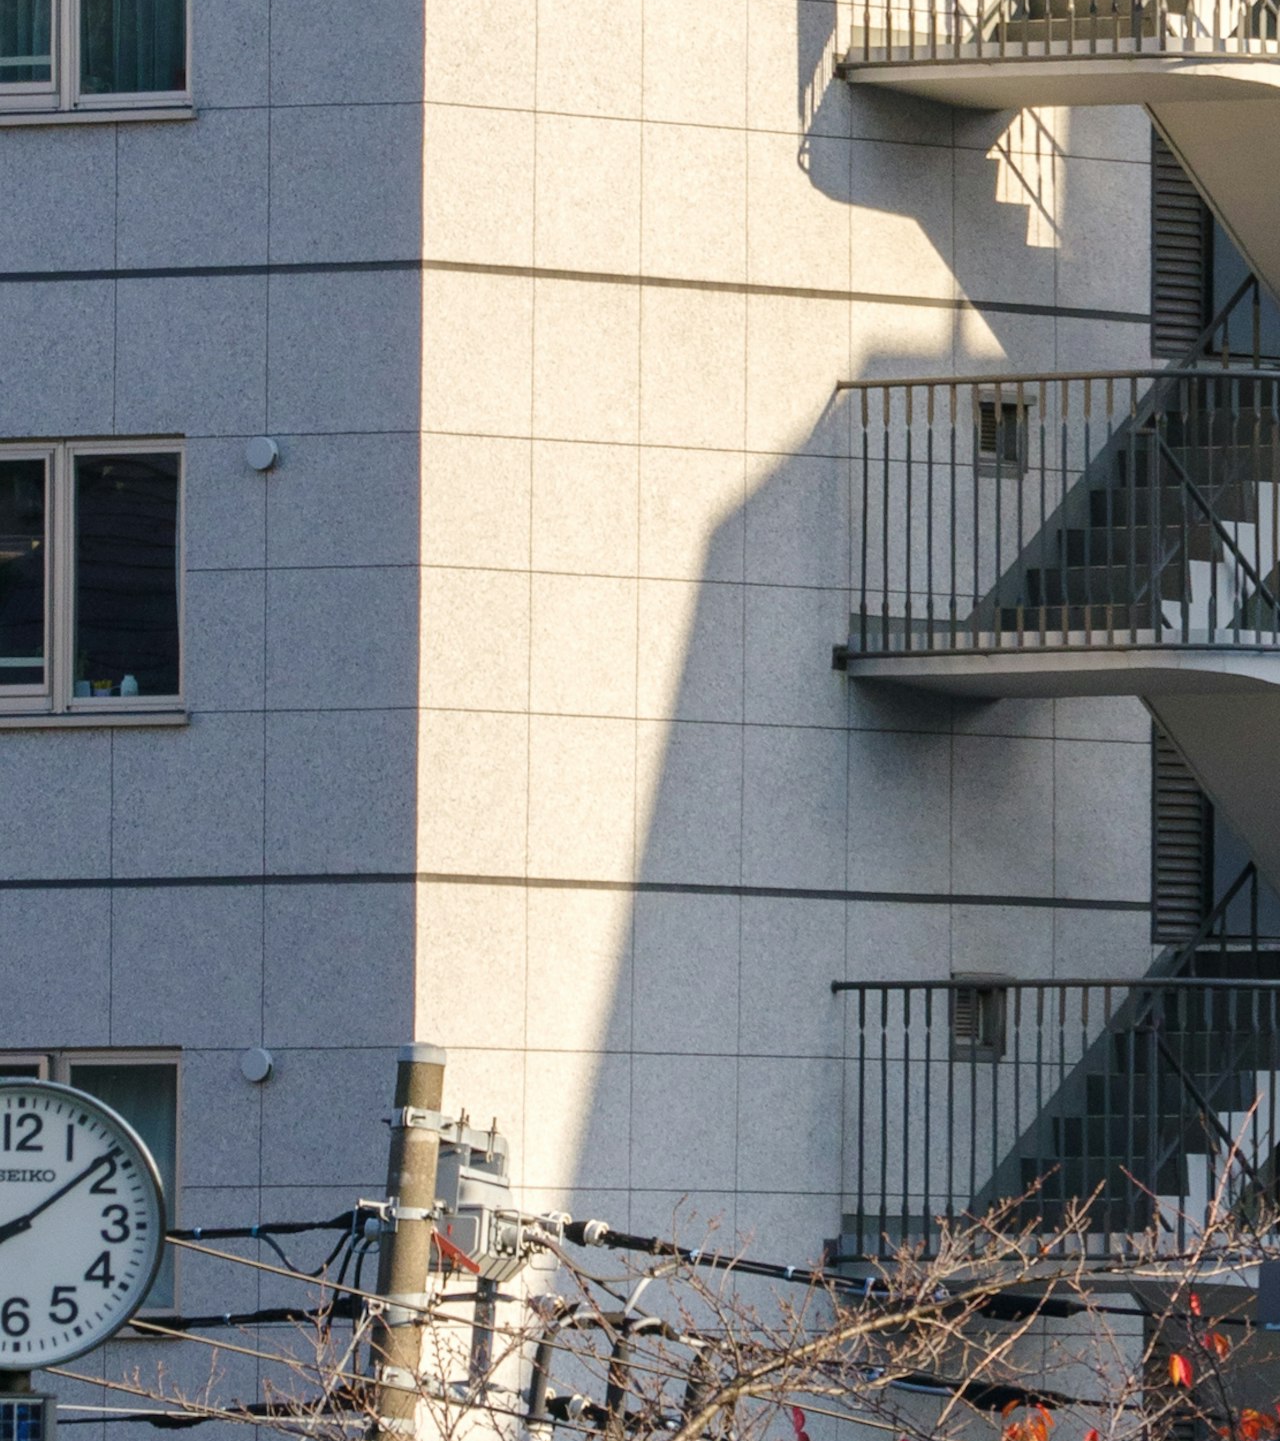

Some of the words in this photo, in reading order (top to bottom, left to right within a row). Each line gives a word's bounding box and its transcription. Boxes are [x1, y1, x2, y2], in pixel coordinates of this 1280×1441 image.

[4, 1113, 43, 1152] 12
[67, 1124, 74, 1162] 1
[90, 1156, 117, 1195] 2
[101, 1204, 130, 1244] 3
[84, 1251, 115, 1289] 4
[1, 1297, 30, 1337] 6
[49, 1286, 78, 1325] 5
